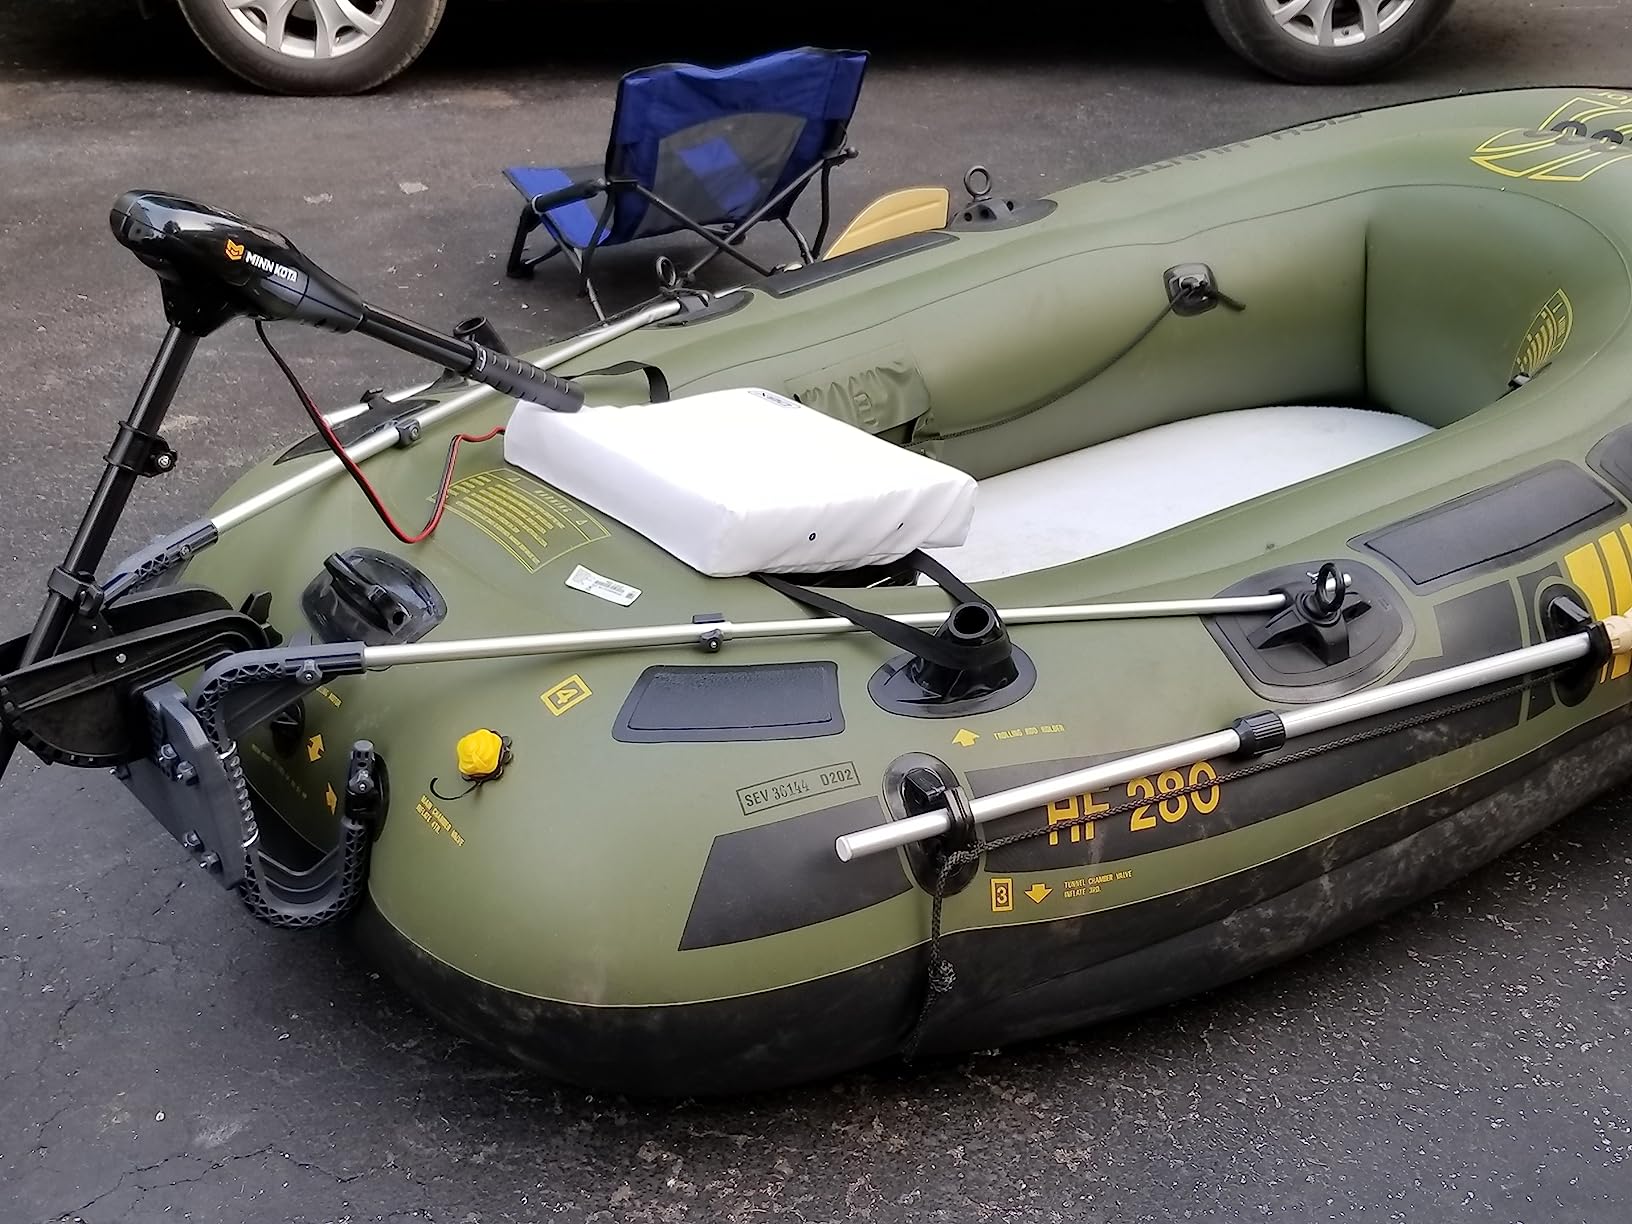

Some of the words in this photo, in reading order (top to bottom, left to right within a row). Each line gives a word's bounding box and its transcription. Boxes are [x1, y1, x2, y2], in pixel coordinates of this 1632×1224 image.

[245, 251, 274, 273] MINN
[274, 263, 298, 282] KOTA
[556, 688, 578, 704] 4
[744, 788, 769, 807] SEV
[820, 768, 853, 786] D202
[1126, 759, 1220, 832] 280
[1064, 879, 1086, 889] TUNNEL
[1088, 873, 1113, 885] CHAMBER
[996, 886, 1008, 904] 3
